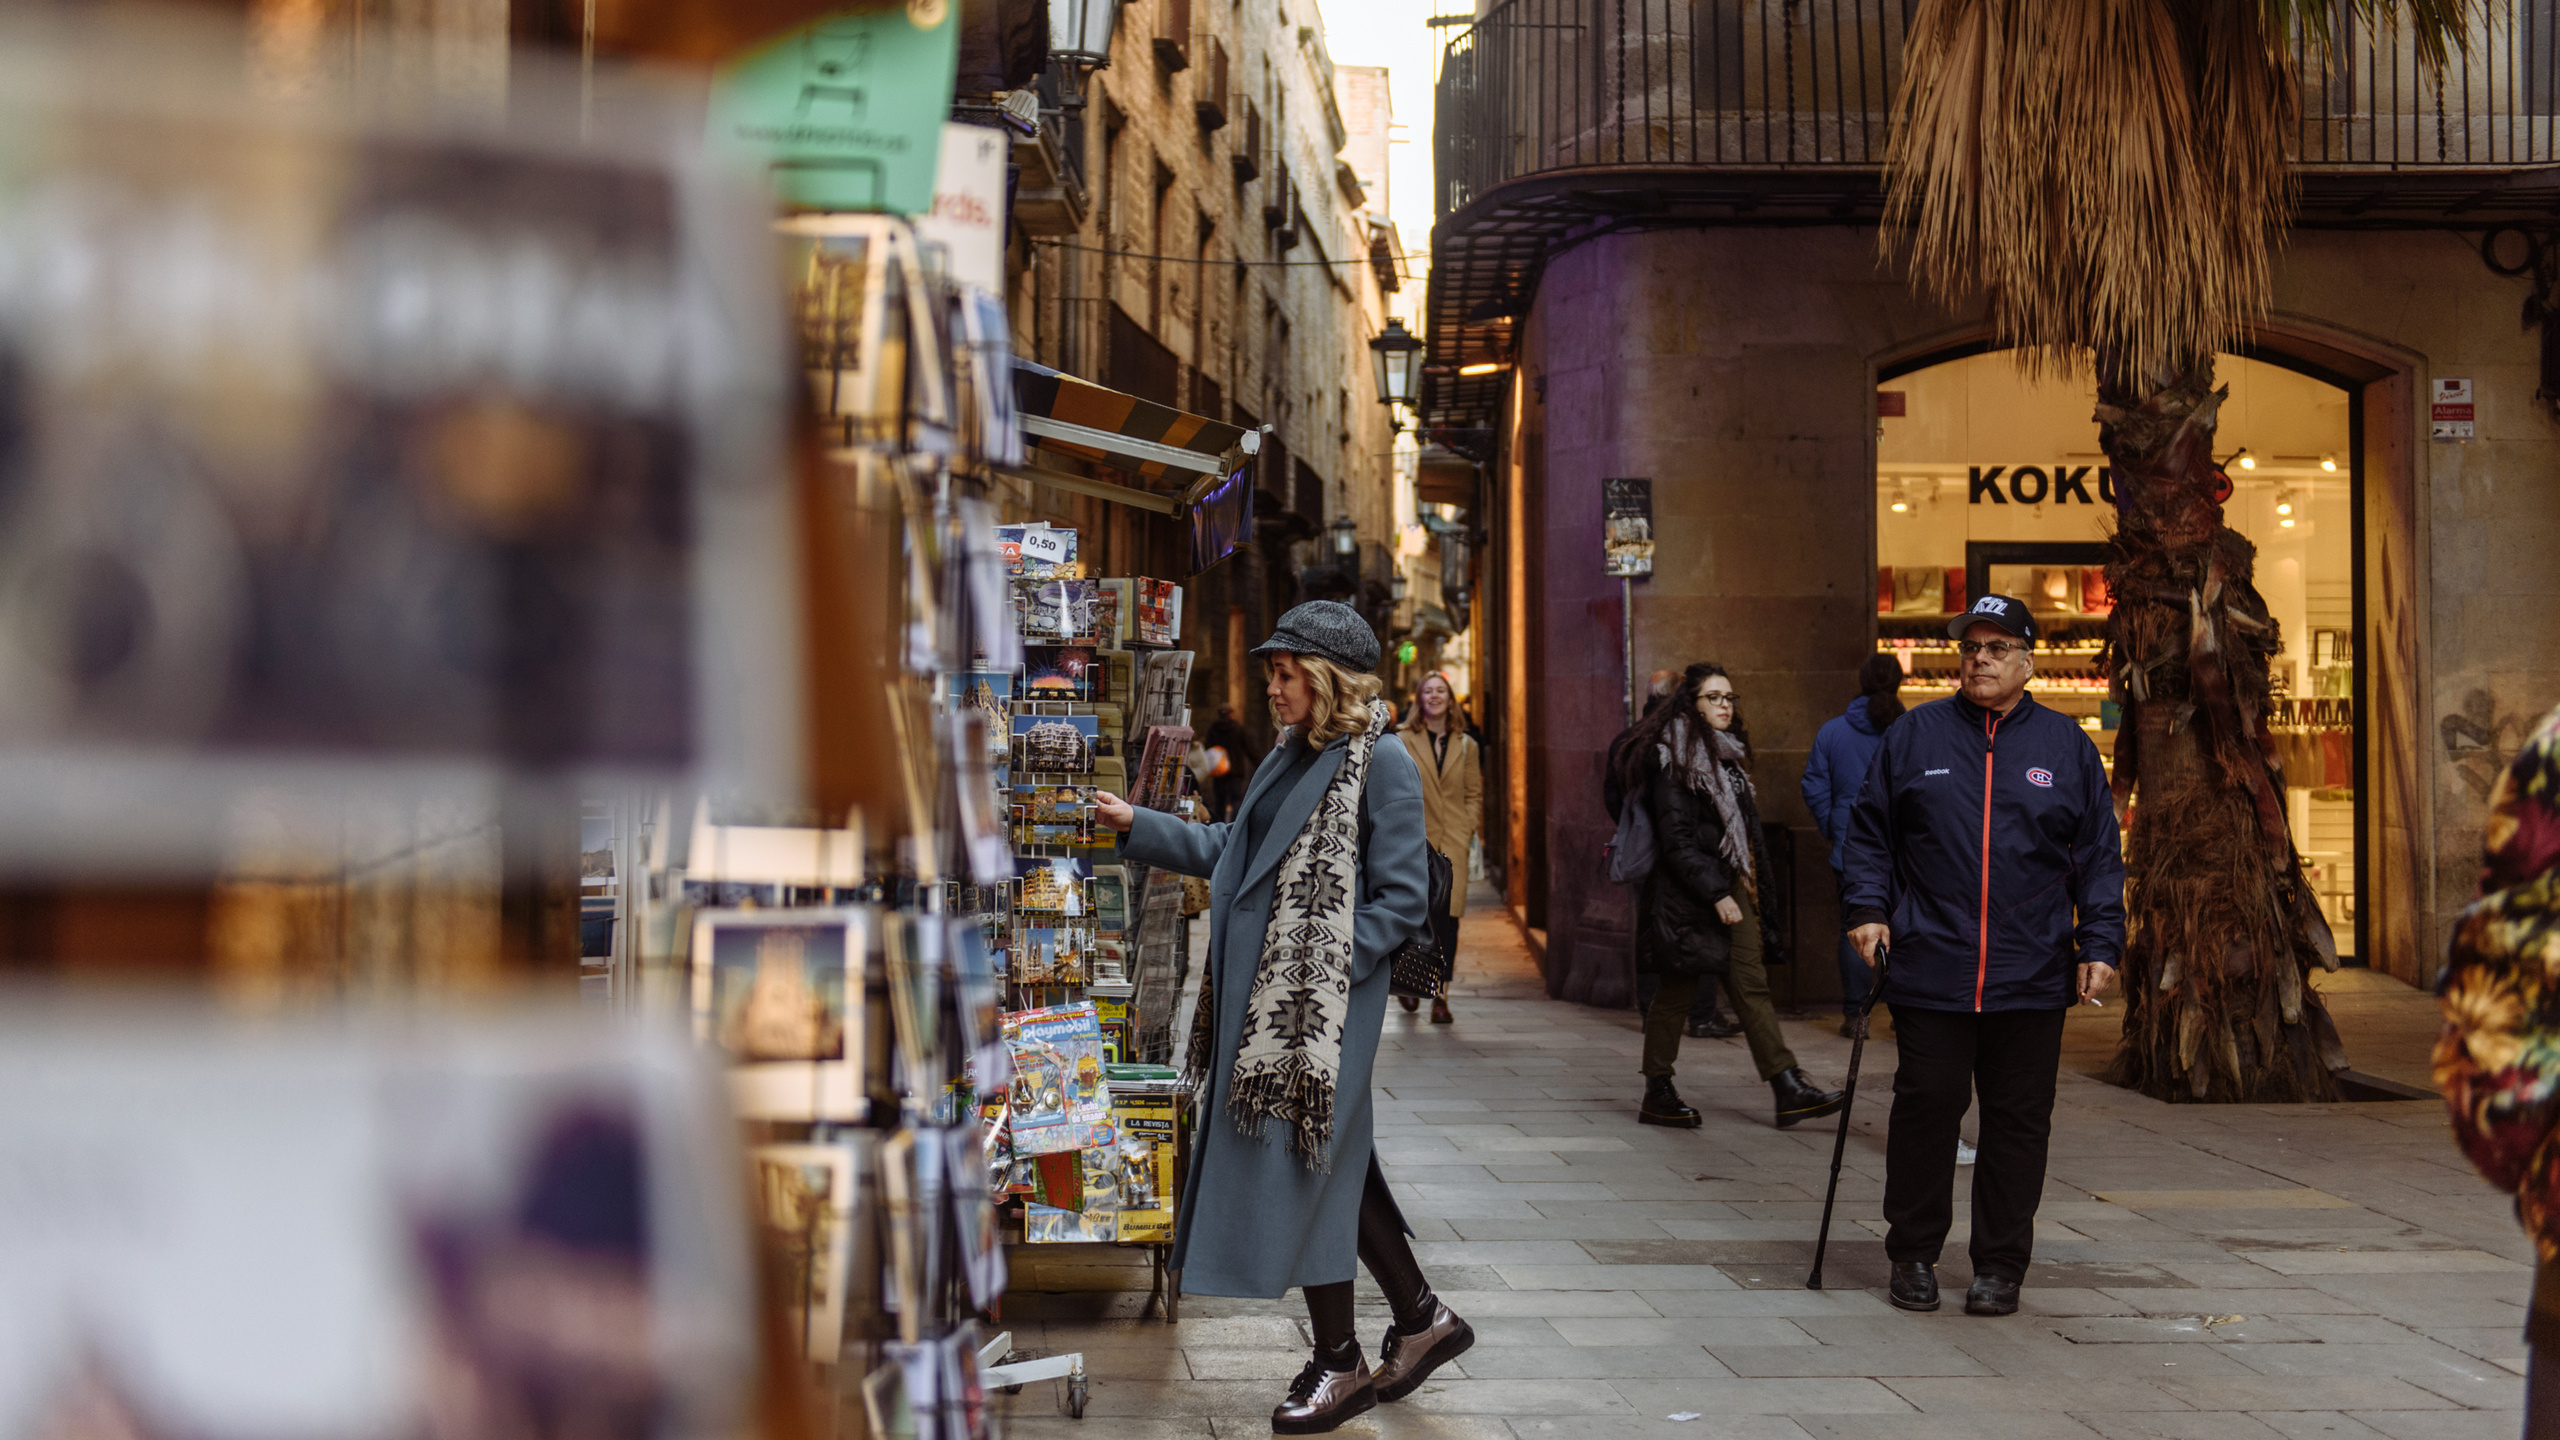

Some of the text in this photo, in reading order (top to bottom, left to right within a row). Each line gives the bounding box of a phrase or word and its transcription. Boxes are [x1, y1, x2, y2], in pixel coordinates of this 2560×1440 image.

[1029, 536, 1056, 551] 0,50
[1925, 768, 1950, 777] Reebok
[1022, 1018, 1091, 1041] playmobil
[1077, 1101, 1099, 1112] Lucha
[1072, 1112, 1107, 1123] de enanos
[1143, 1121, 1170, 1129] REVISTA
